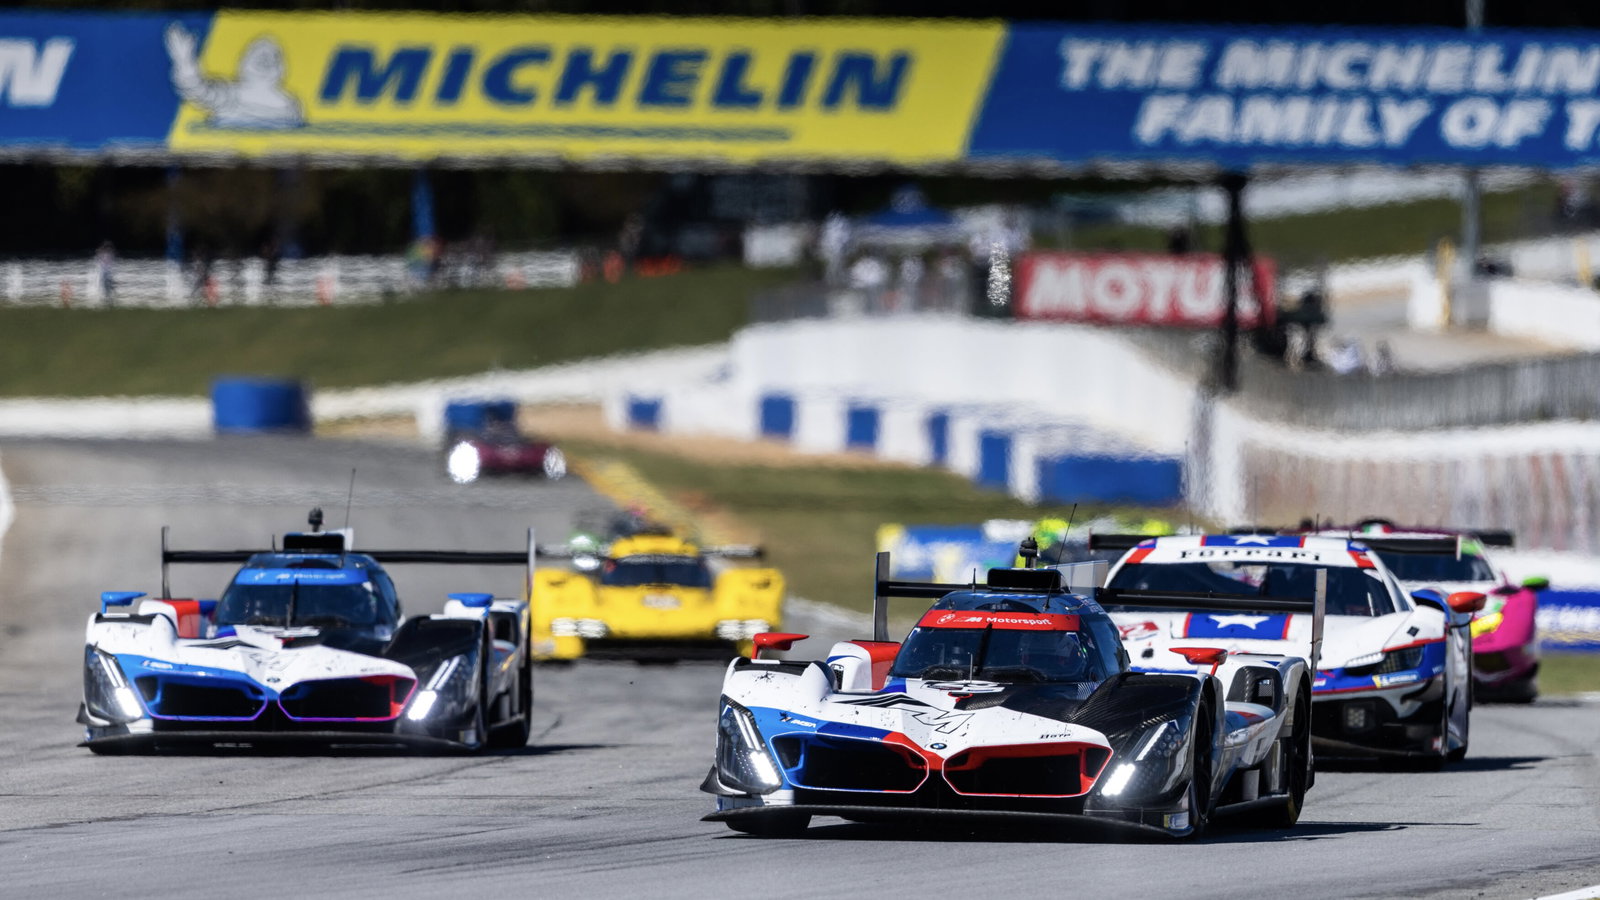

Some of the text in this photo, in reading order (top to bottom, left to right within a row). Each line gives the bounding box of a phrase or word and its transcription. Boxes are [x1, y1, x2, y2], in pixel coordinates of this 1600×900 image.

[318, 44, 912, 111] MICHELIN
[1060, 38, 1600, 93] THE MICHELIN
[1135, 94, 1432, 147] FAMILY
[1442, 98, 1551, 148] OF
[1180, 549, 1321, 562] Ferrari
[986, 616, 1052, 626] Motorsport
